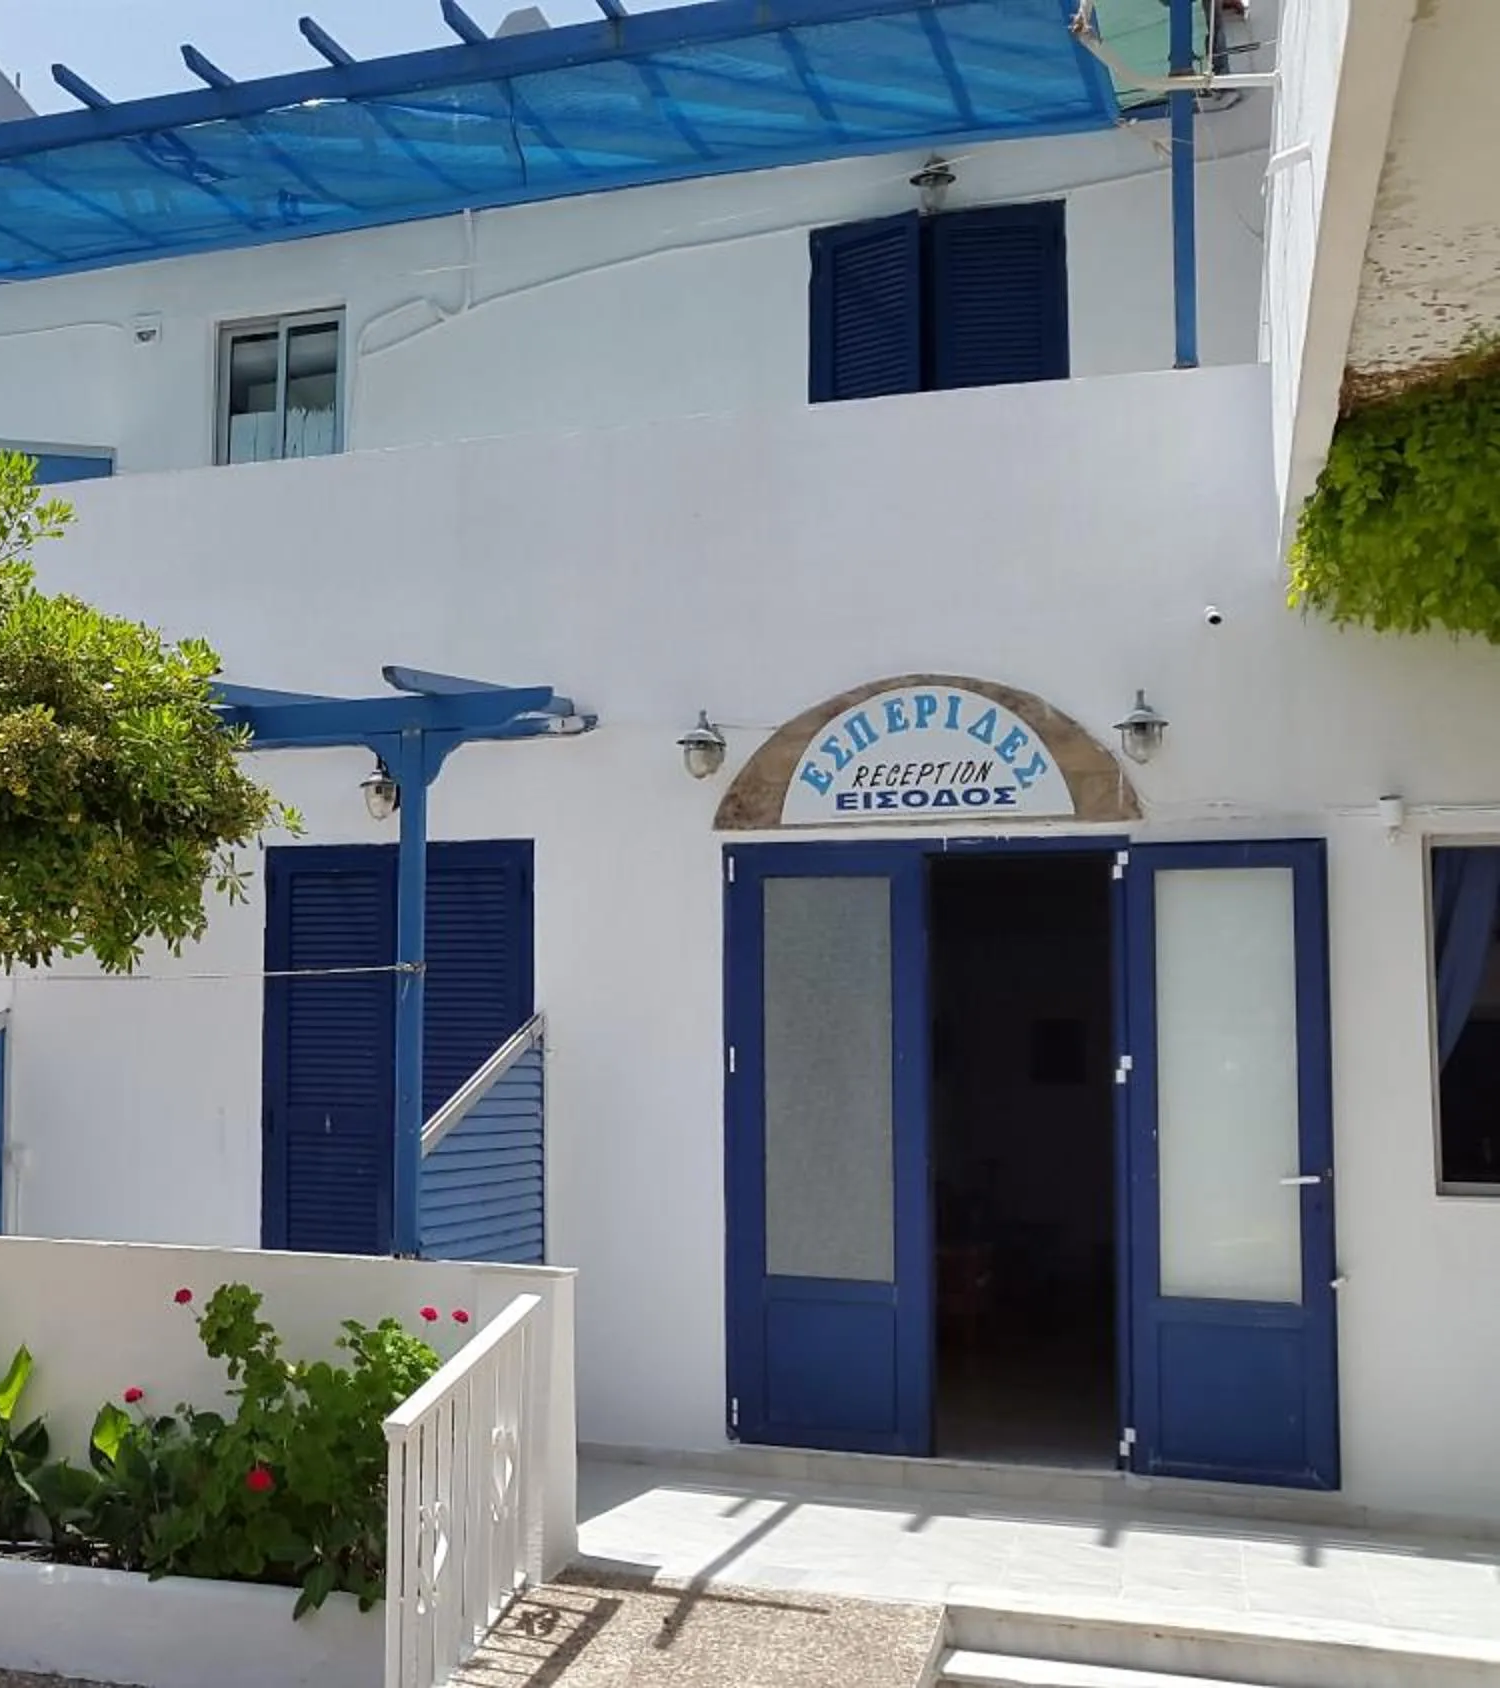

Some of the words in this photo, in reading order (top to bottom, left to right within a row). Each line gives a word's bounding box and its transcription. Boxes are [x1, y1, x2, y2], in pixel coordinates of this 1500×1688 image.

[800, 694, 1047, 796] ΕΣΠΕΡΙΔΕΣ
[851, 760, 994, 788] RECEPTION
[835, 786, 1017, 810] ΕΙΣΟΔΟΣ
